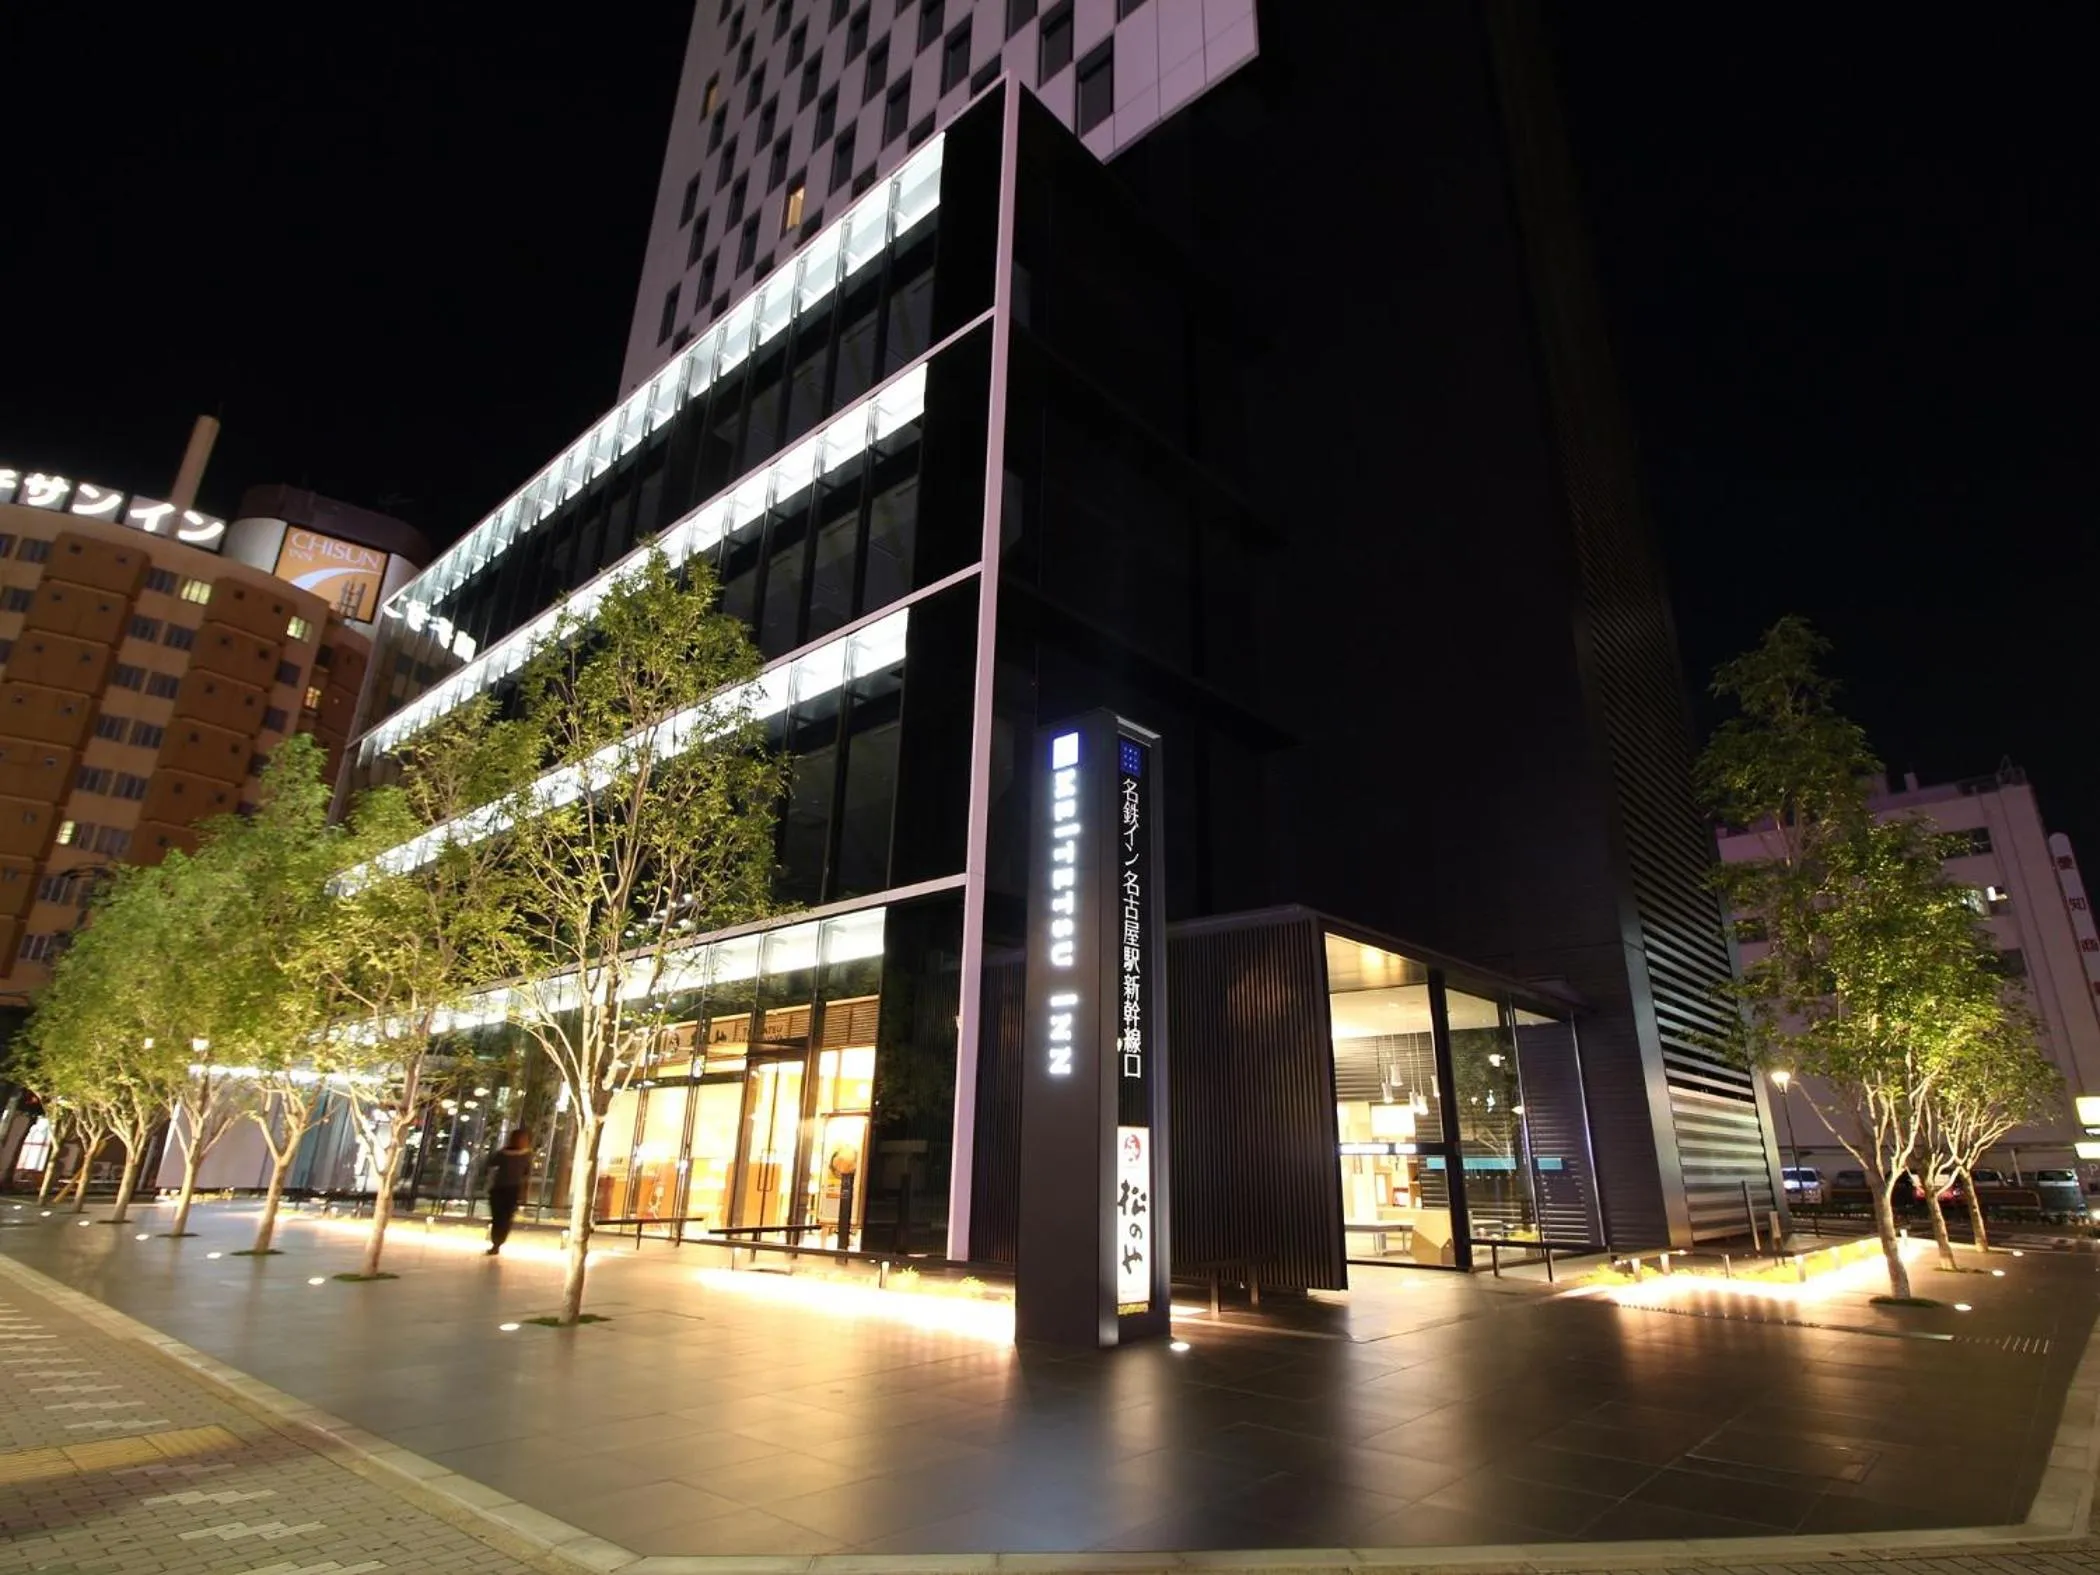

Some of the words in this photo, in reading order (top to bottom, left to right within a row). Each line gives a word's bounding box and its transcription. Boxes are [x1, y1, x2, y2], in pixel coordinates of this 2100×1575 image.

[291, 532, 380, 569] CHISUN
[1051, 768, 1080, 967] MEITETSU
[1121, 778, 1141, 1078] 名鉄イン名古屋駅新幹線口
[1049, 993, 1078, 1074] INN
[1117, 1178, 1147, 1275] 松のや
